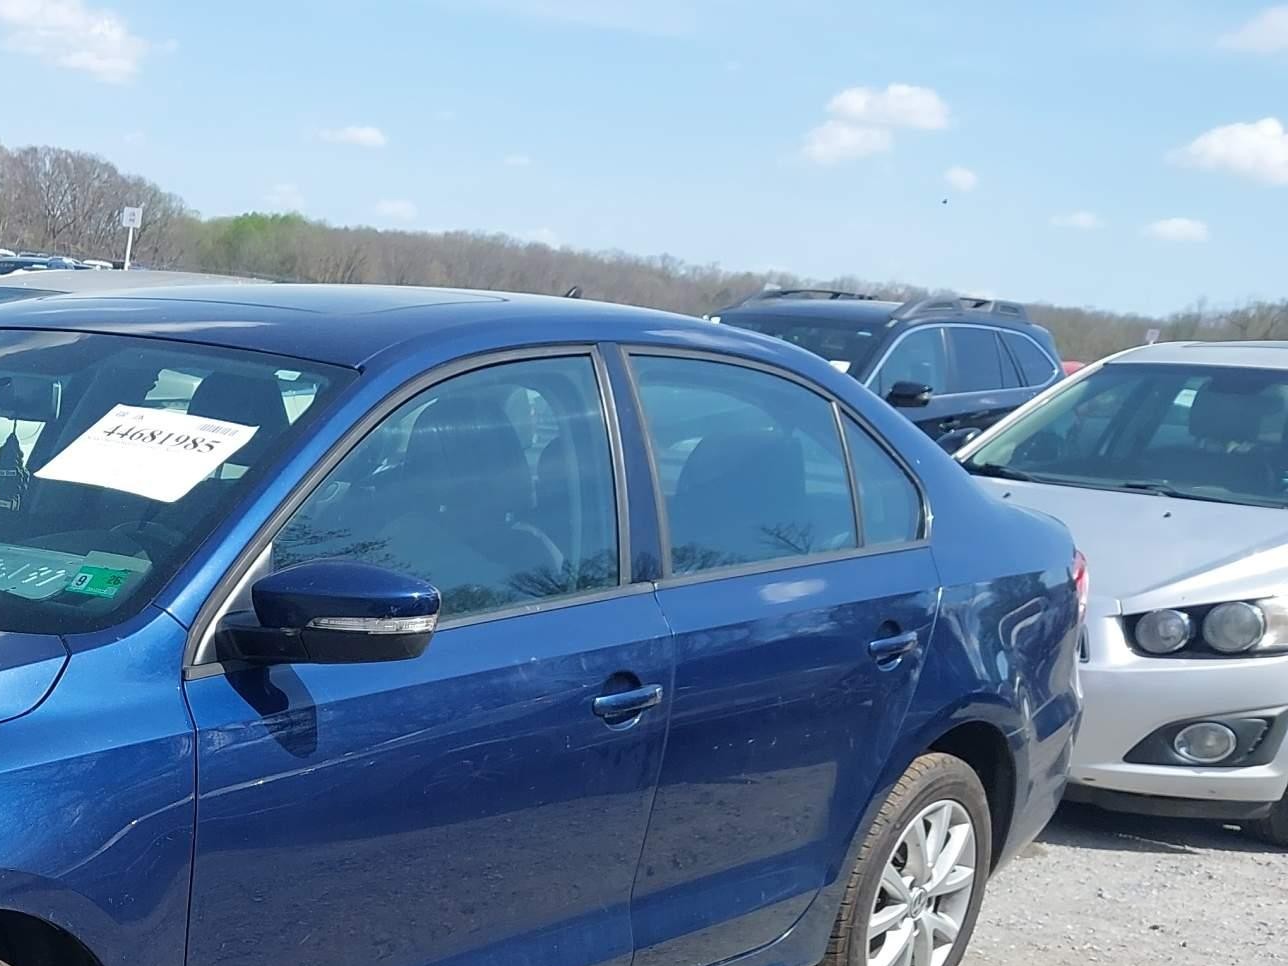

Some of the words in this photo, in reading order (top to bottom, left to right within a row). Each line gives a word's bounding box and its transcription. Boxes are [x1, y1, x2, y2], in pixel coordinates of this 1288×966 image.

[103, 423, 221, 454] 44681985
[75, 575, 88, 586] 9
[107, 574, 124, 586] 26
